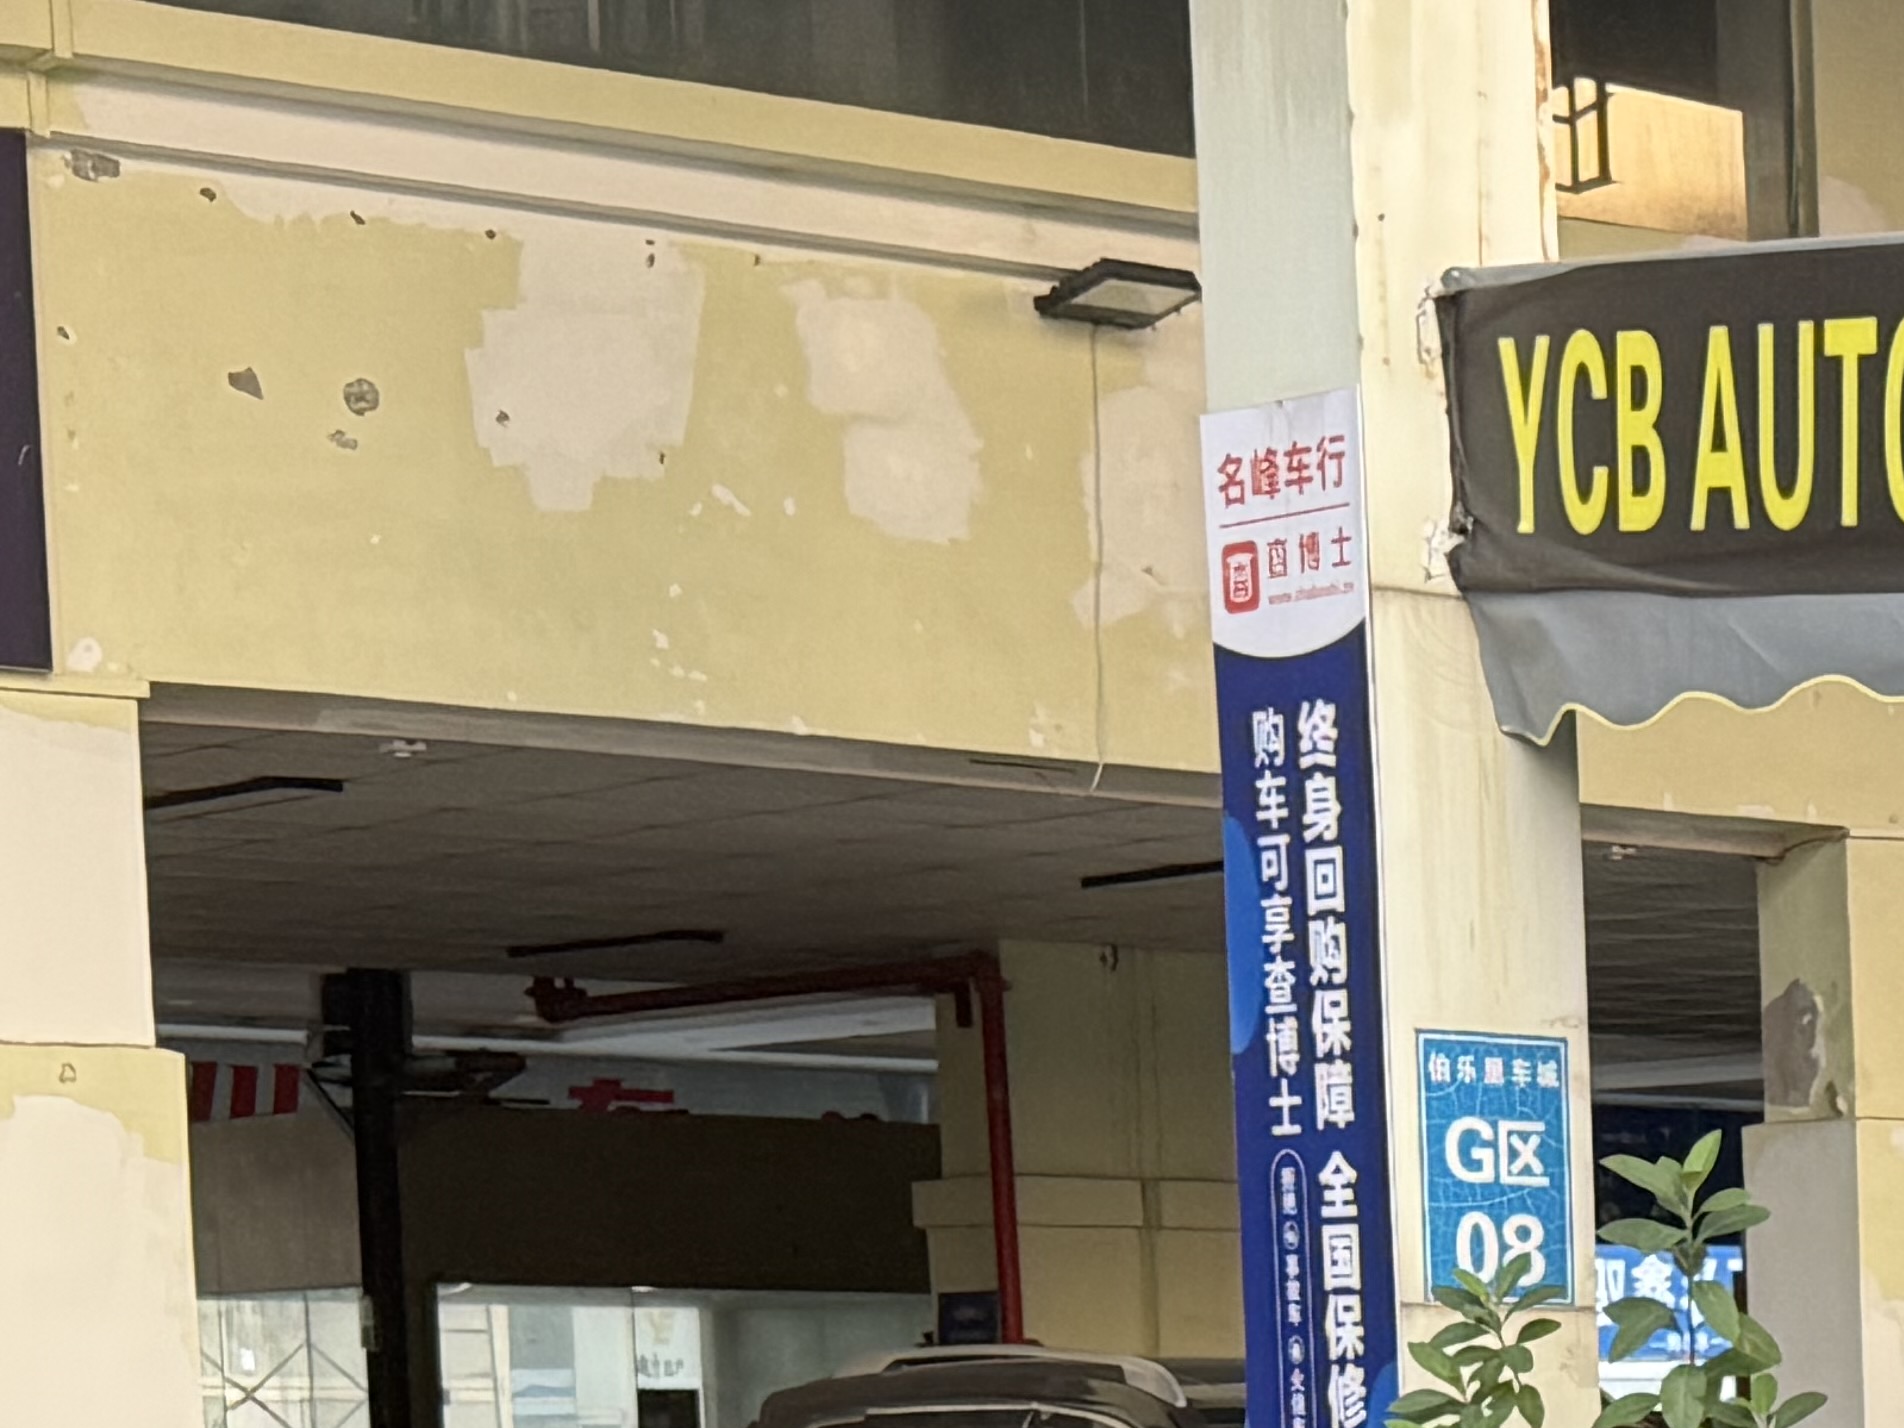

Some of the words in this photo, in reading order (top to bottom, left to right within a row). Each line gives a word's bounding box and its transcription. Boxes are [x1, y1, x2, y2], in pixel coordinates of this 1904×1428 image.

[1217, 435, 1346, 509] 名峰车行
[1497, 328, 1667, 535] YCB
[1250, 706, 1303, 1138] 购车可享查博士
[1297, 699, 1356, 1131] 终身回购保障
[1445, 1116, 1551, 1188] G区
[1455, 1211, 1546, 1287] 08
